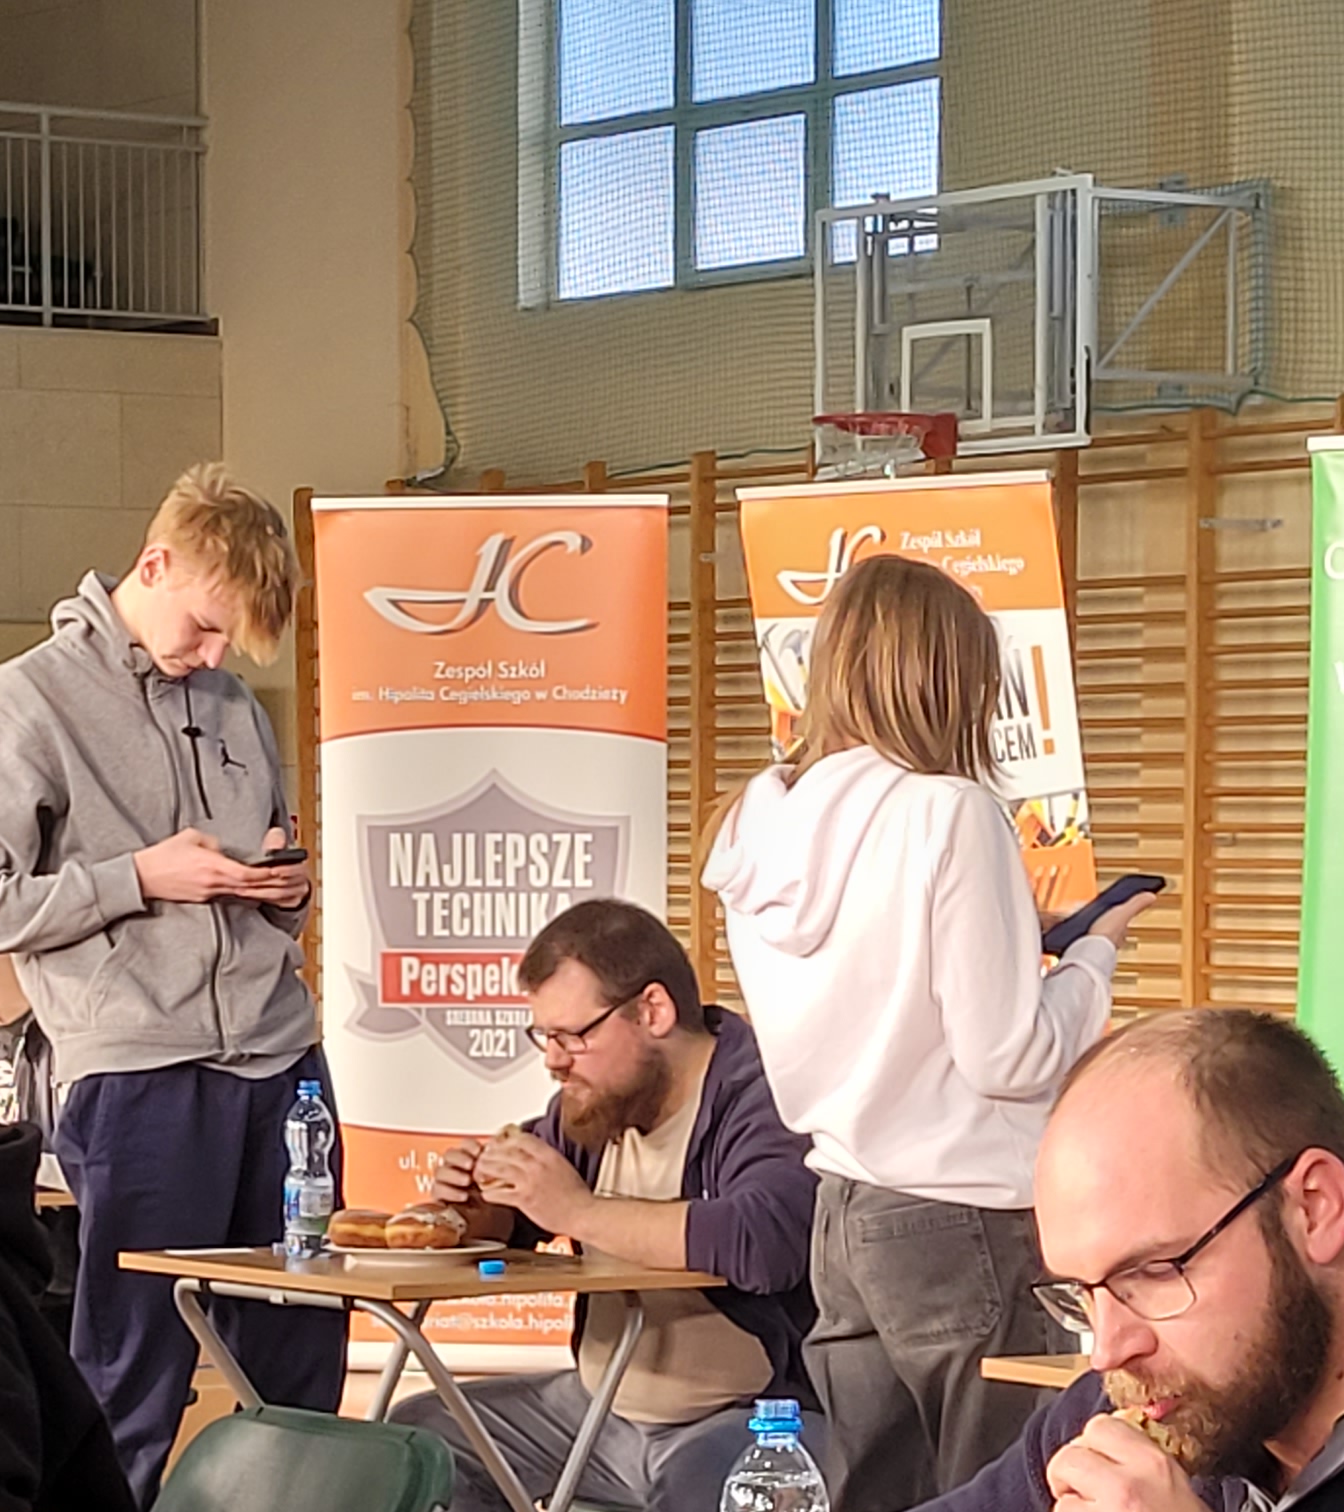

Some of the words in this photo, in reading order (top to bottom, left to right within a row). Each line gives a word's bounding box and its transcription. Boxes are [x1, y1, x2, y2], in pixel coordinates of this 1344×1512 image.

[389, 832, 594, 888] NAJLEPSZE
[400, 955, 530, 1001] Perspek
[468, 1028, 516, 1058] 2021
